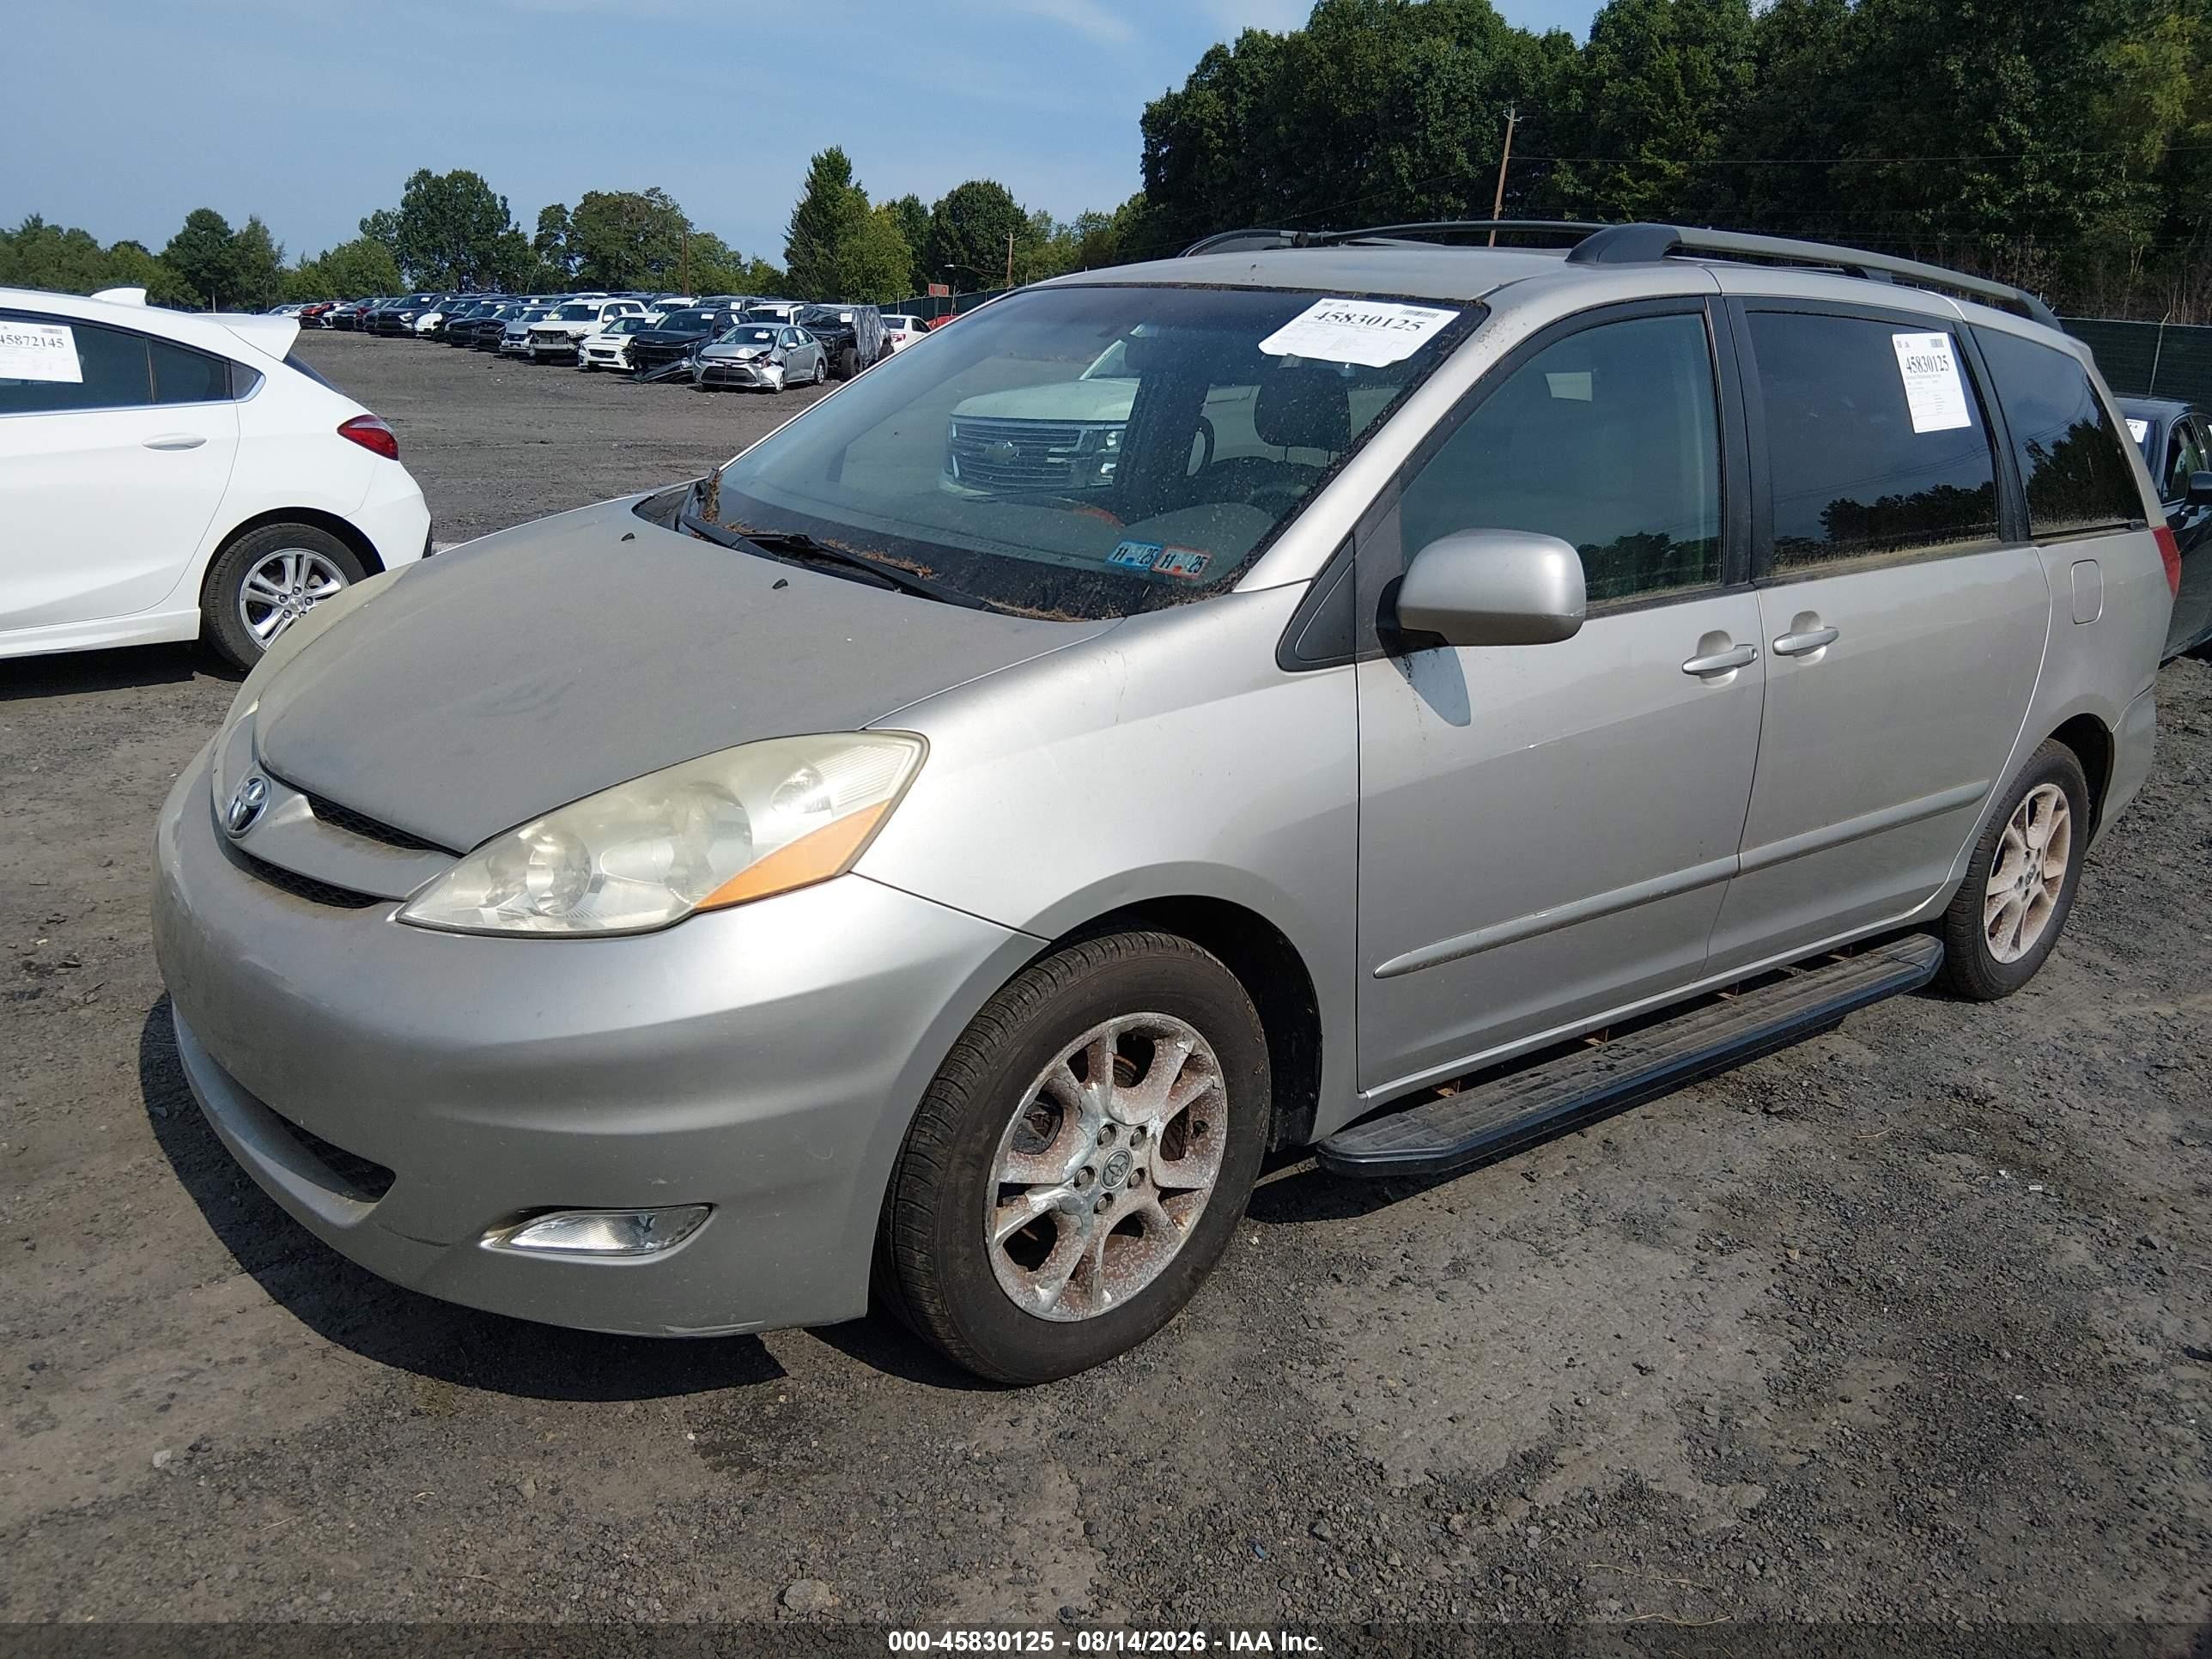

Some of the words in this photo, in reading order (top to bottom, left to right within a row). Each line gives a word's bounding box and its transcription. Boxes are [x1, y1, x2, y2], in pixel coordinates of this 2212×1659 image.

[1314, 311, 1425, 331] 45830125
[0, 334, 64, 349] 45872145
[1906, 355, 1949, 374] 45830125
[1112, 546, 1129, 561] 11
[1139, 548, 1159, 564] 25
[1159, 554, 1176, 568] 11
[1188, 556, 1207, 573] 25
